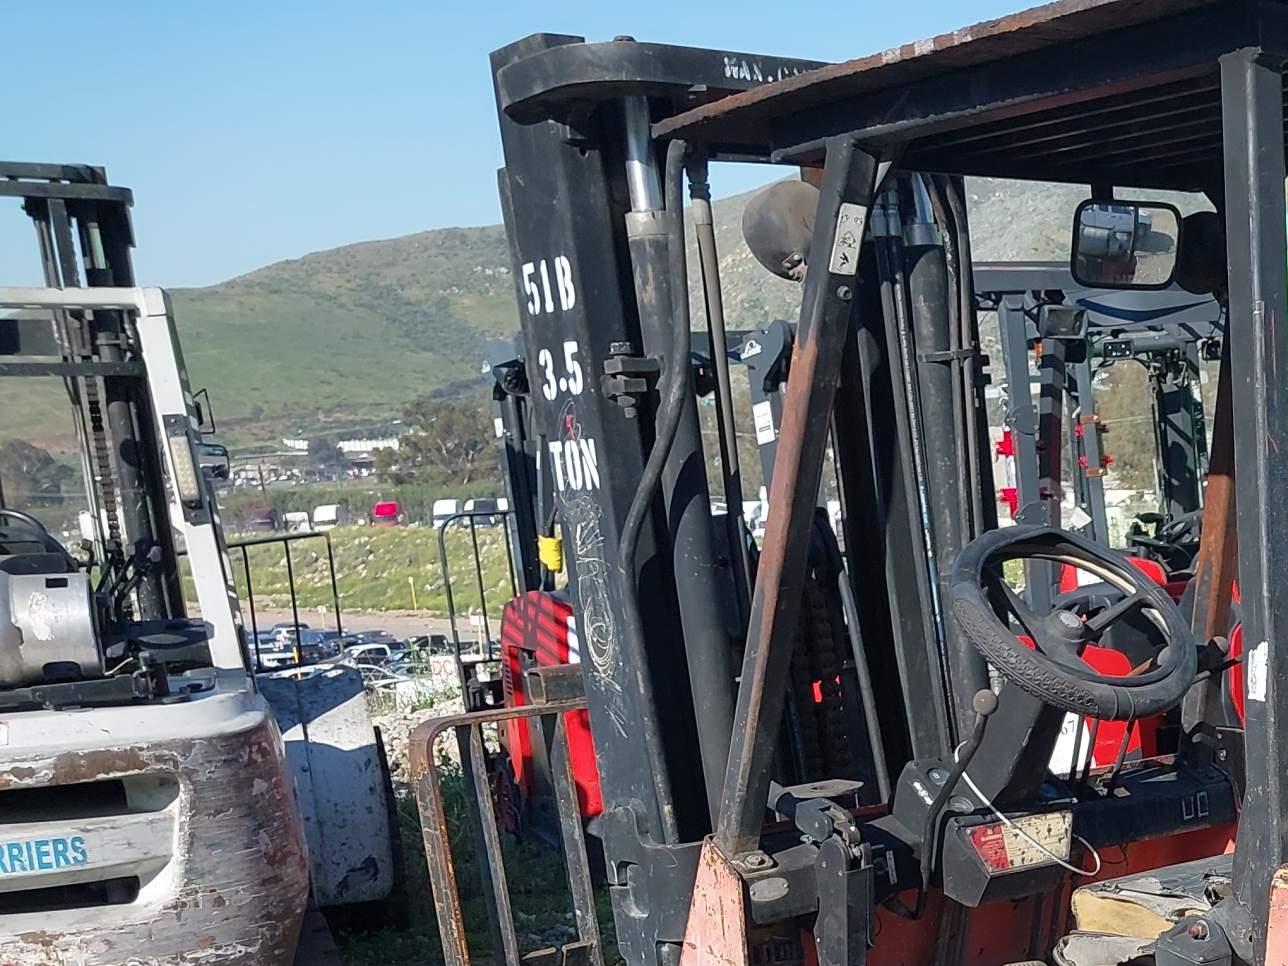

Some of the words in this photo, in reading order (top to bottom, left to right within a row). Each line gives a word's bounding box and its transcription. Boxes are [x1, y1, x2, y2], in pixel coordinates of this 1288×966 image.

[522, 255, 576, 316] 51B
[538, 340, 584, 401] 3.5
[549, 437, 600, 492] TON
